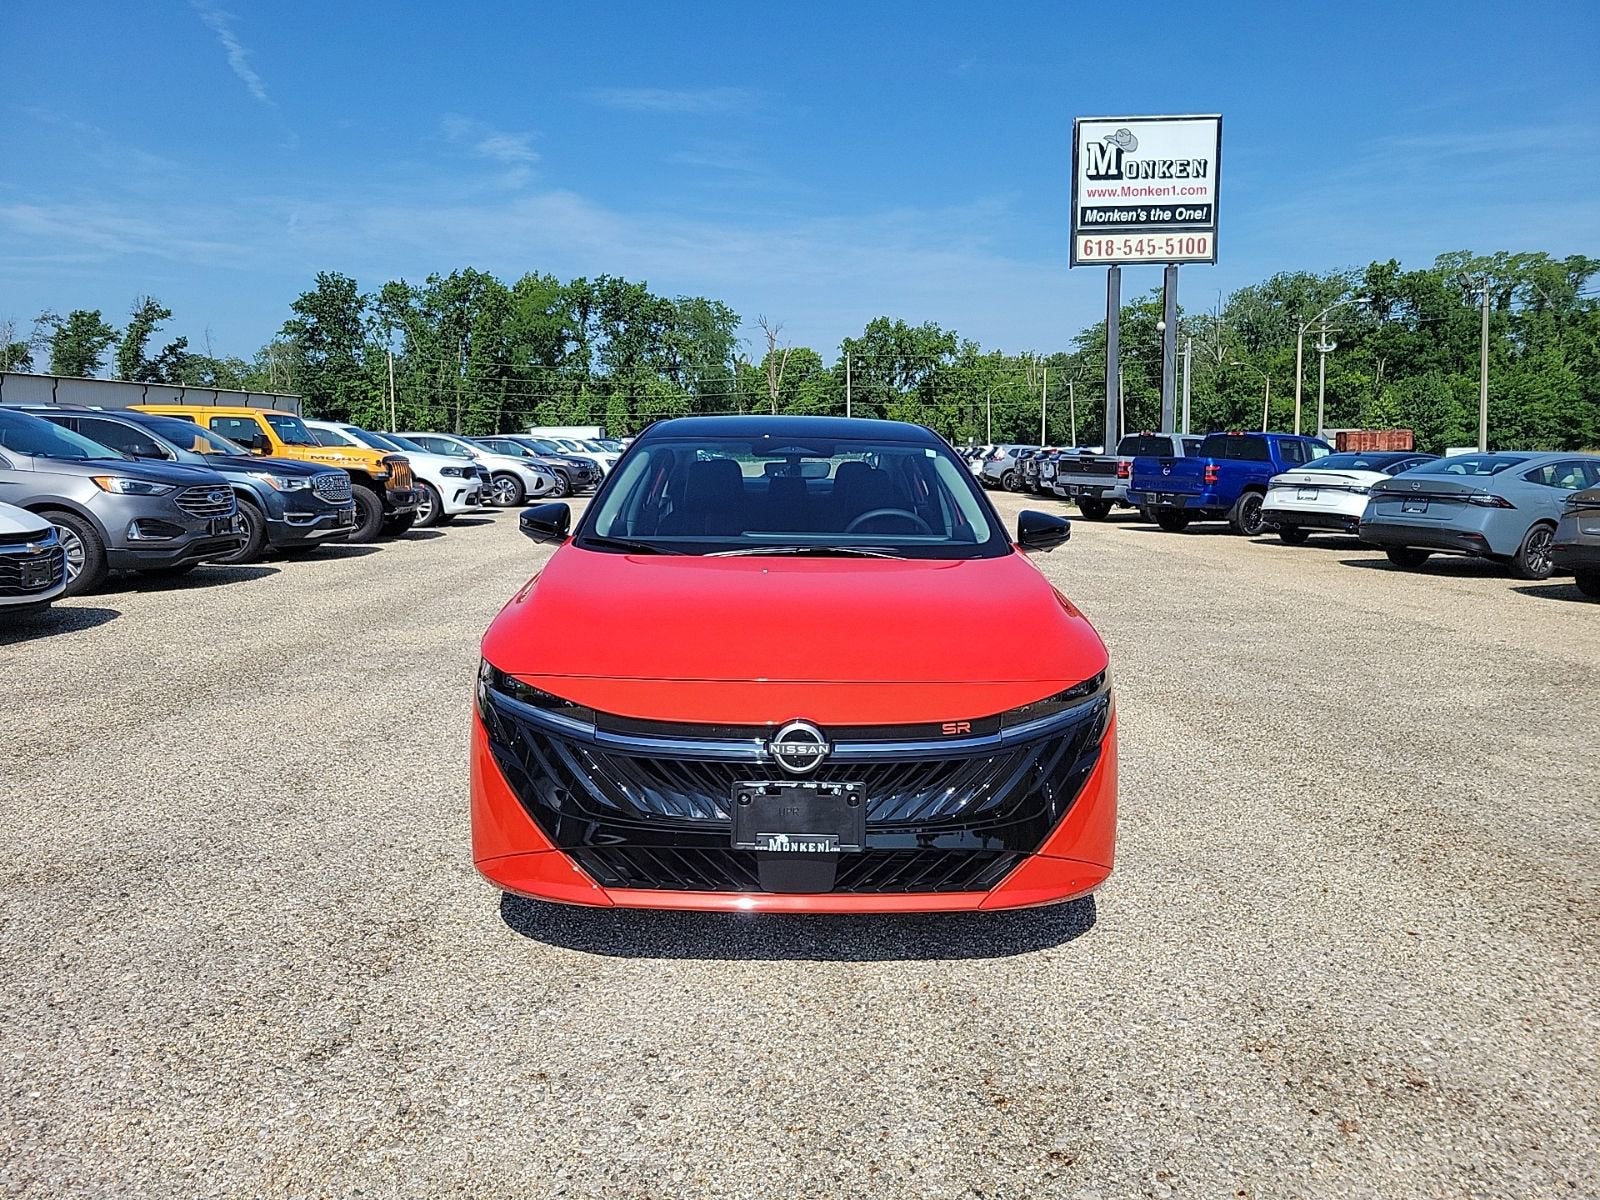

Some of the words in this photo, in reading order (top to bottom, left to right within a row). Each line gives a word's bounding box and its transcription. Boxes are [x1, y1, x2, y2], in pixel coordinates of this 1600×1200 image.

[1086, 141, 1208, 181] MONKEN
[1087, 185, 1207, 198] www.Monken1.com
[1084, 209, 1147, 222] Monken's
[1150, 208, 1172, 221] the
[1175, 207, 1208, 220] One!
[1083, 237, 1207, 257] 618-545-5100
[942, 722, 971, 734] SR
[770, 744, 829, 754] NISSAN
